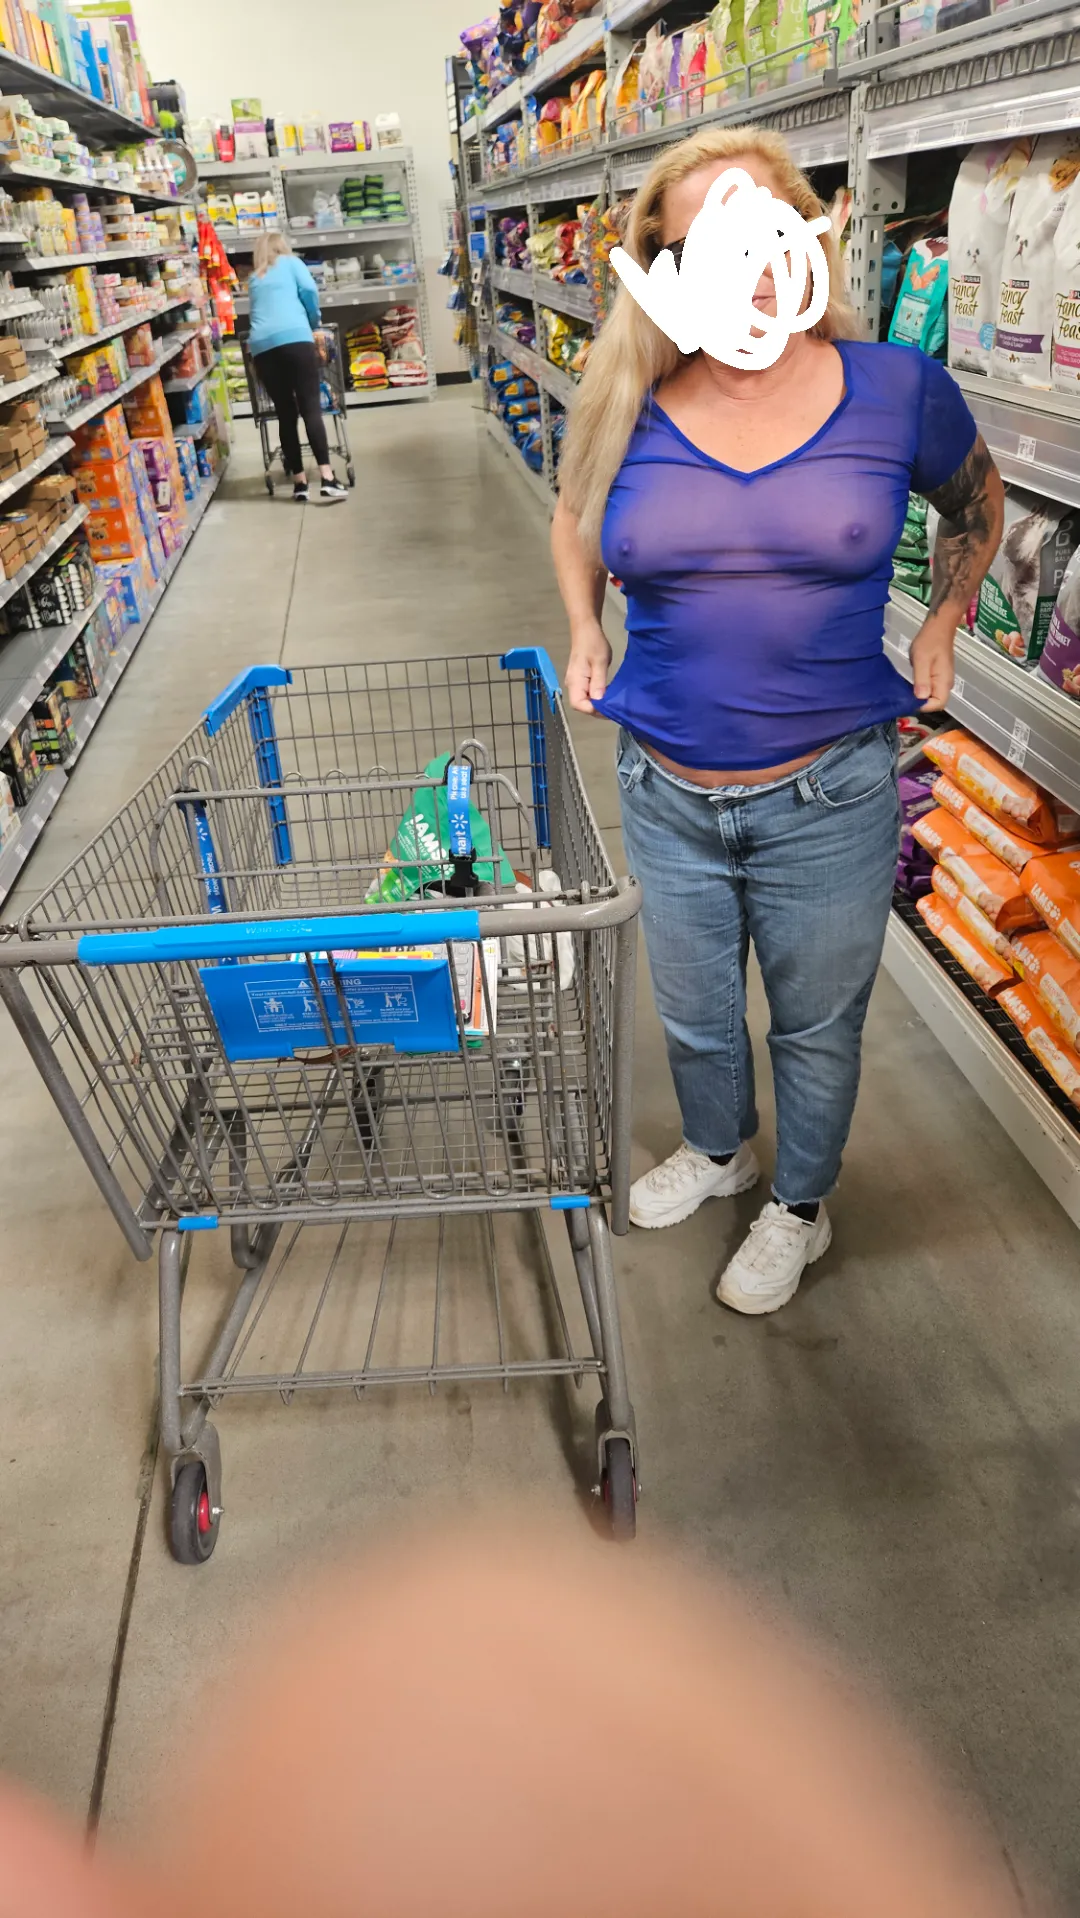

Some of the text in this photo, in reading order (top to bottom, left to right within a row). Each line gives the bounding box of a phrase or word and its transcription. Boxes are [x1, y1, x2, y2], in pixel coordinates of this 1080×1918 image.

[951, 277, 980, 303] Fancy
[1001, 282, 1028, 310] Fancy
[953, 296, 979, 316] Feast
[1000, 303, 1025, 326] Feast
[1055, 293, 1080, 318] Fanc
[1057, 316, 1080, 340] Feas
[410, 813, 447, 861] IAMS
[1031, 883, 1054, 913] IAMS
[1011, 936, 1035, 967] IAMS
[309, 978, 362, 988] ARING
[1001, 989, 1024, 1018] IAMS
